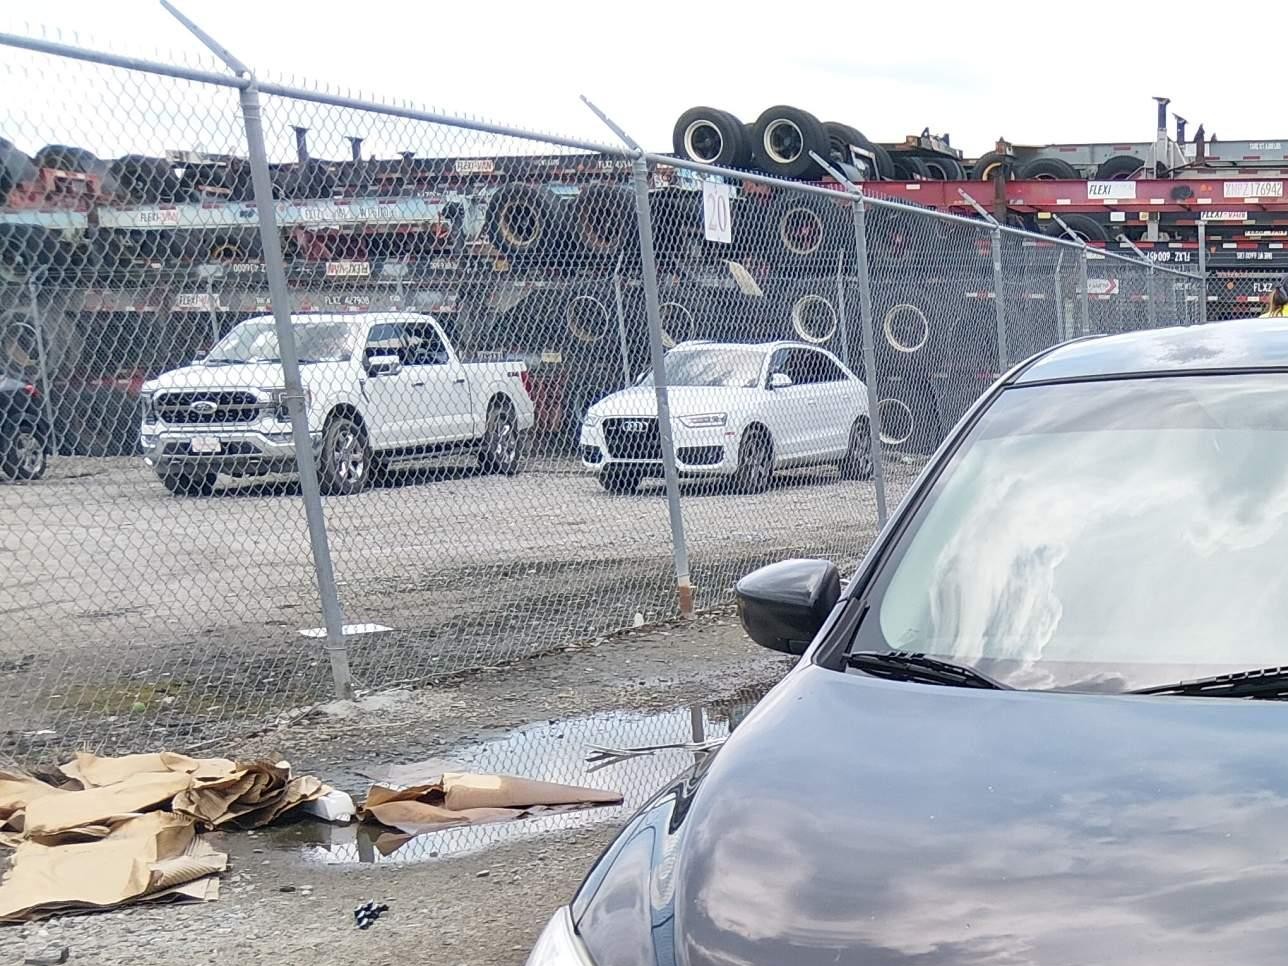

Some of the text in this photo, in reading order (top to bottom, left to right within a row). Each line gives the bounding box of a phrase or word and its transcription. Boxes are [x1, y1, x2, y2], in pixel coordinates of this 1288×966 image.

[1088, 183, 1113, 196] FLEXI
[706, 193, 729, 232] 20
[1174, 252, 1191, 262] FLXZ
[1253, 282, 1273, 292] FLXZ
